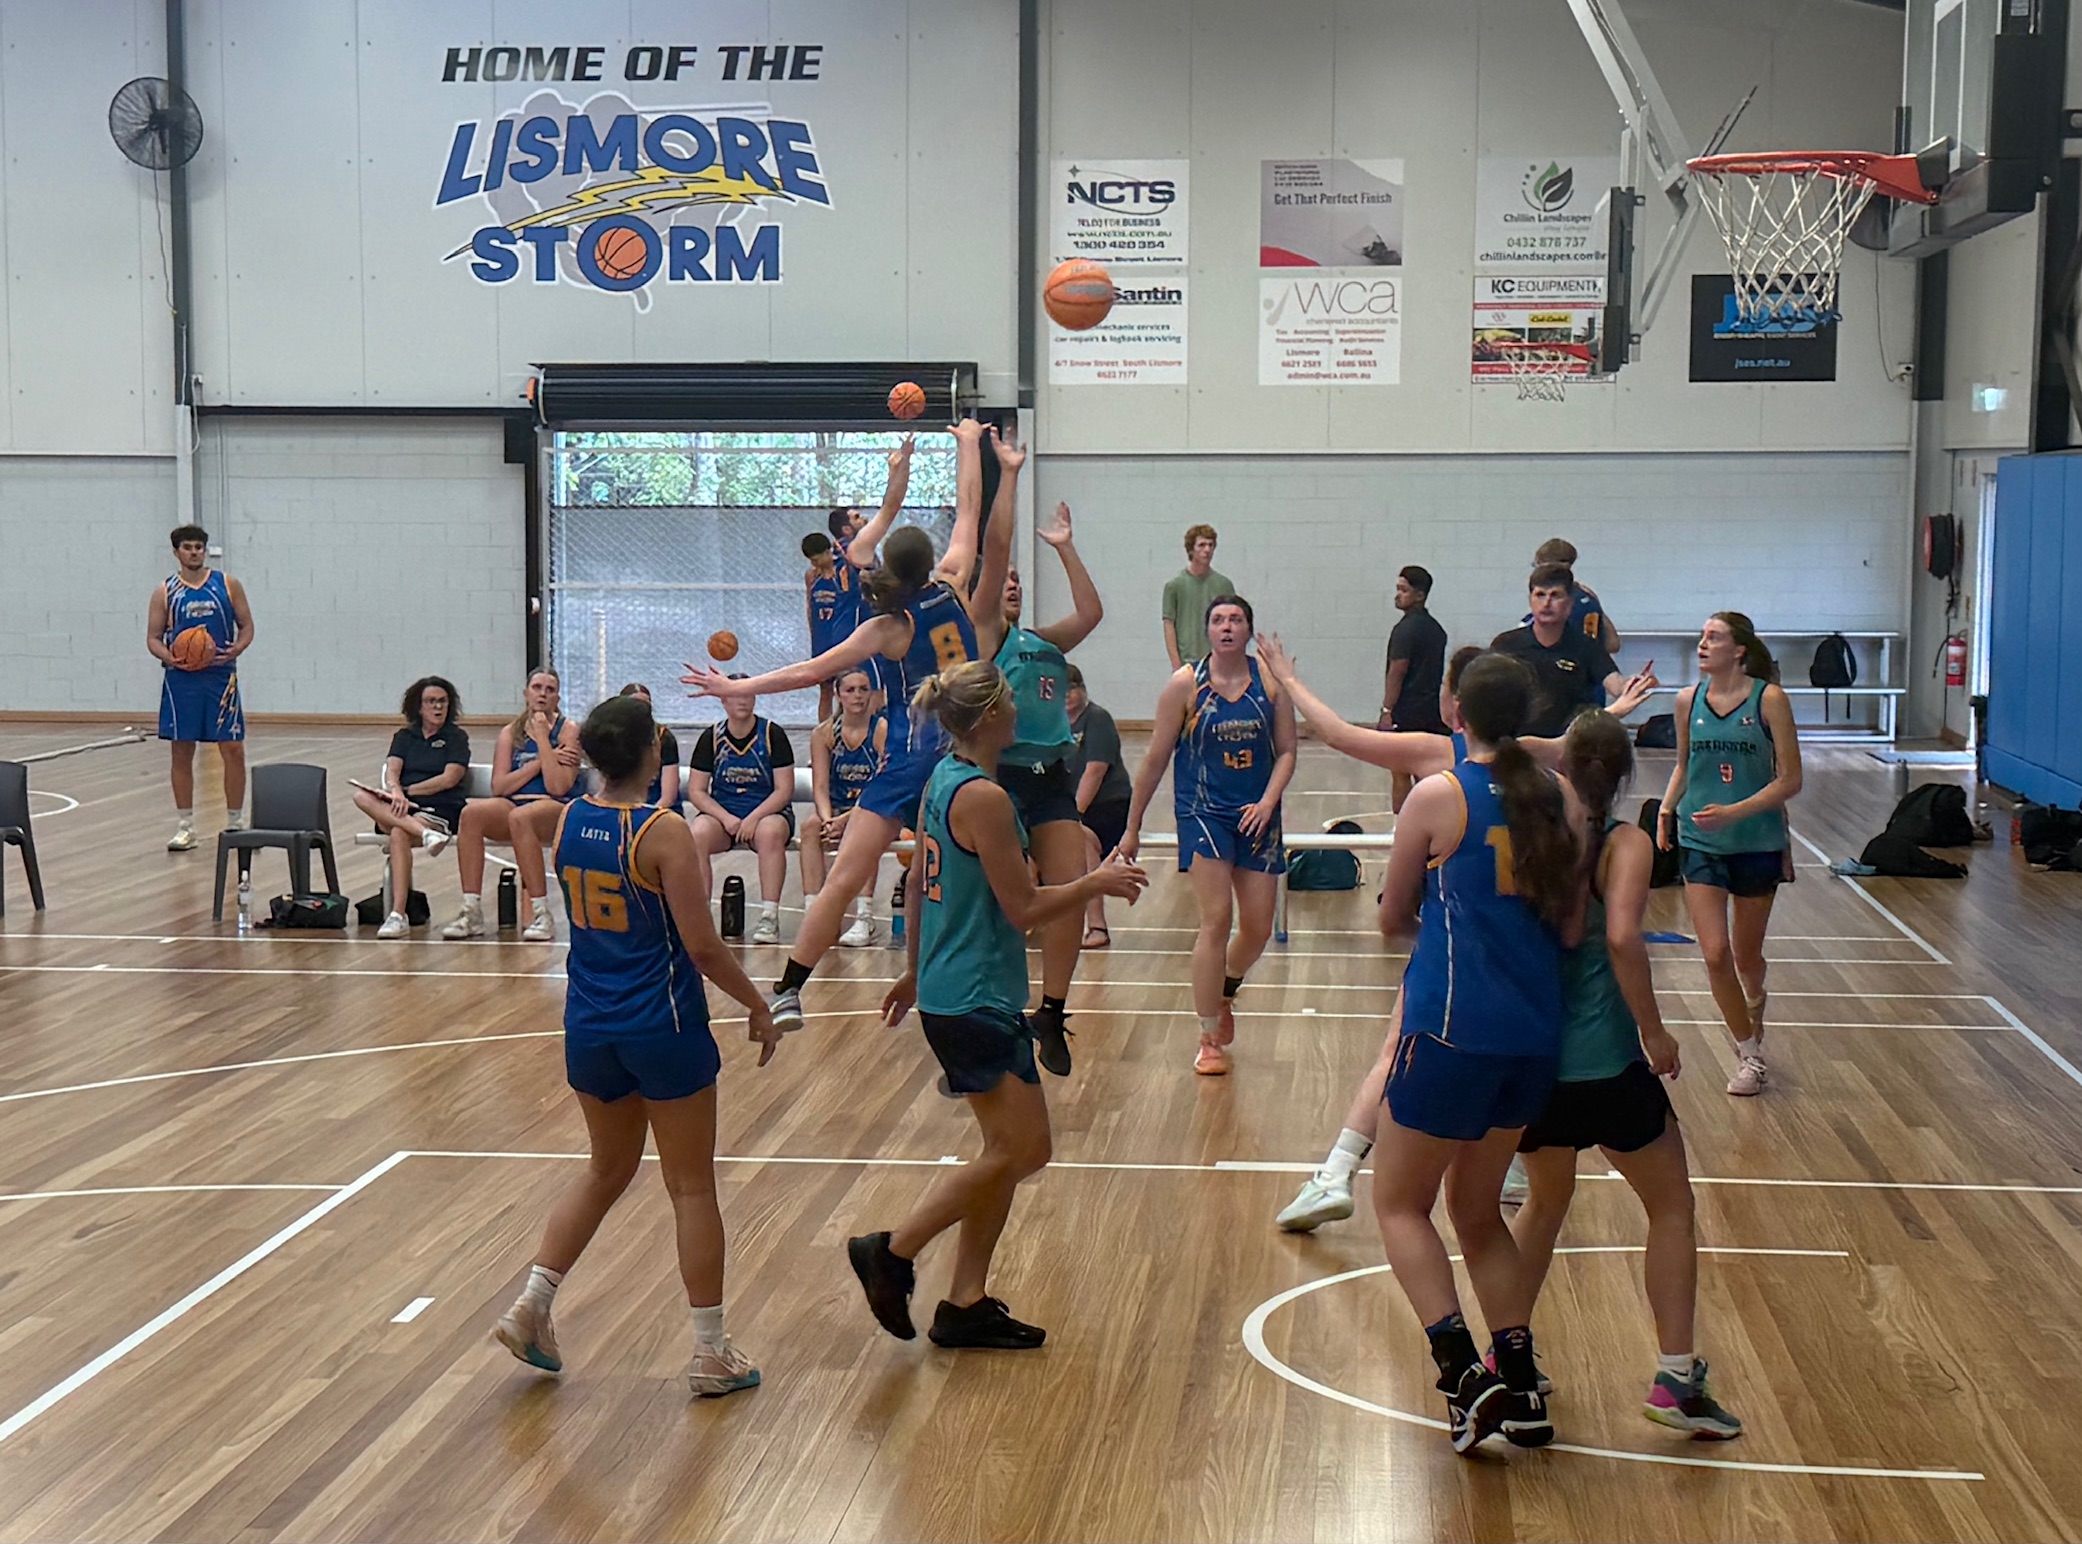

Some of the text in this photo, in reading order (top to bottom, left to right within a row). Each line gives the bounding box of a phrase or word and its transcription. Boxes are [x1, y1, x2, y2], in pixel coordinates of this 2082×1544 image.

[442, 45, 823, 82] HOME OF THE
[435, 114, 831, 206] LISMORE
[1068, 181, 1175, 204] NCTS
[1274, 192, 1392, 205] Get That Perfect Finish
[1503, 213, 1592, 224] Chillin Landscapes
[471, 214, 781, 292] STORM
[1507, 237, 1536, 248] 0432
[1295, 281, 1398, 314] wca
[1491, 279, 1515, 293] KC
[563, 865, 630, 933] 16
